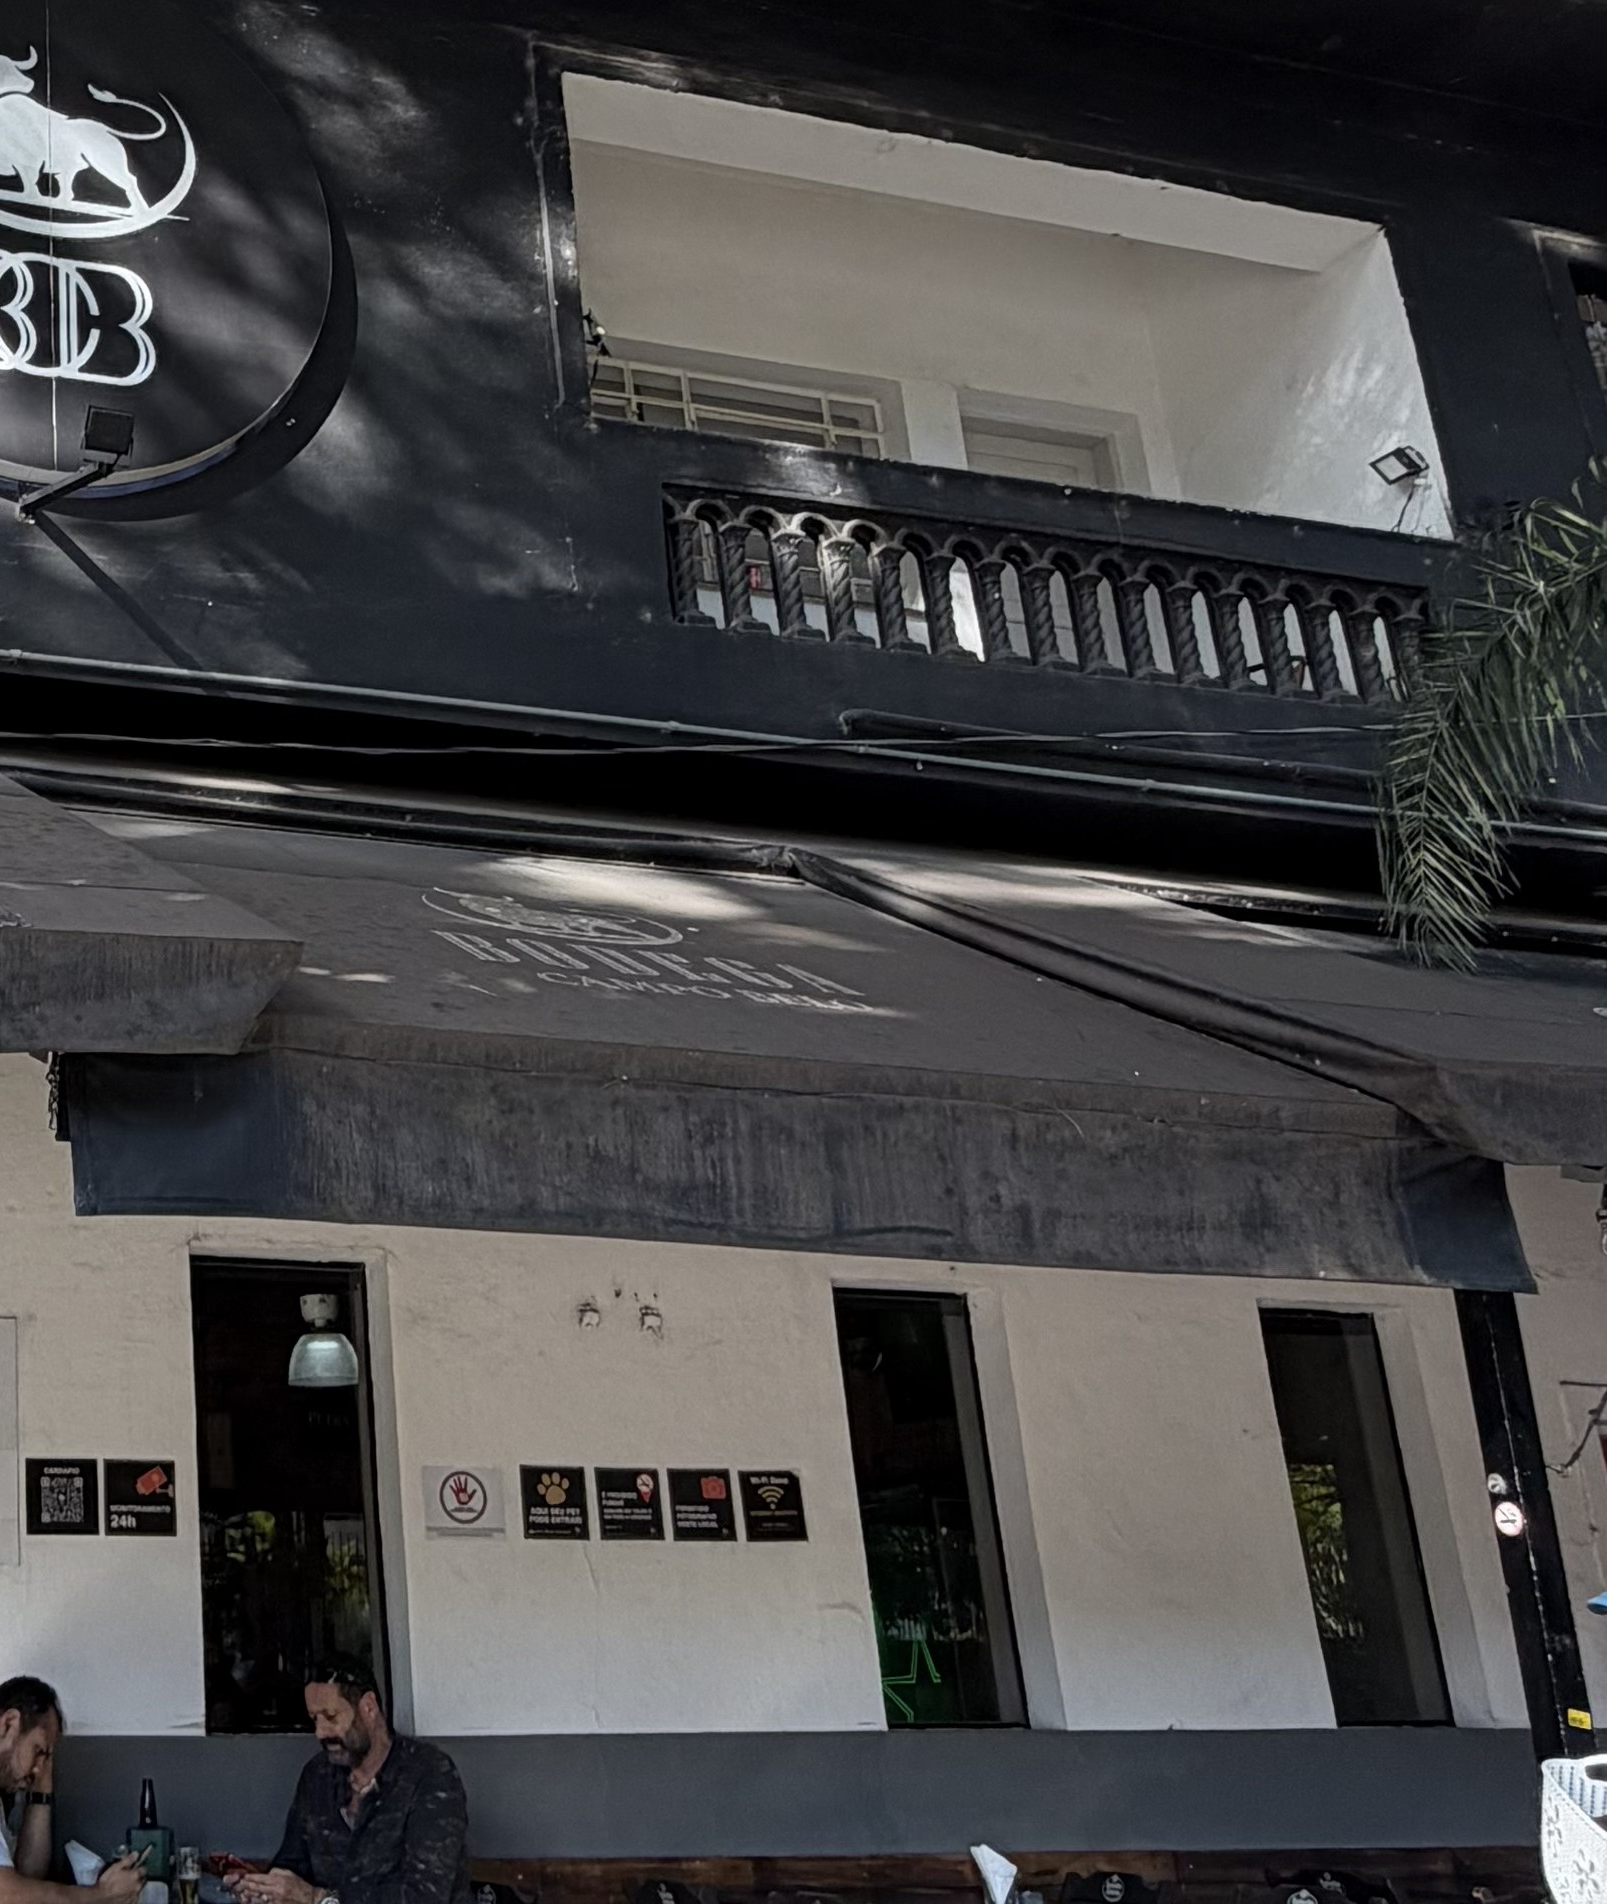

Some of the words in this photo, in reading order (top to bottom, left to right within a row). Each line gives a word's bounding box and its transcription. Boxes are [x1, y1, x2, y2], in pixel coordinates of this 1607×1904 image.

[430, 929, 865, 996] BODEGA
[536, 971, 732, 999] CAMPO
[735, 989, 874, 1012] BELO
[110, 1514, 136, 1528] 24h
